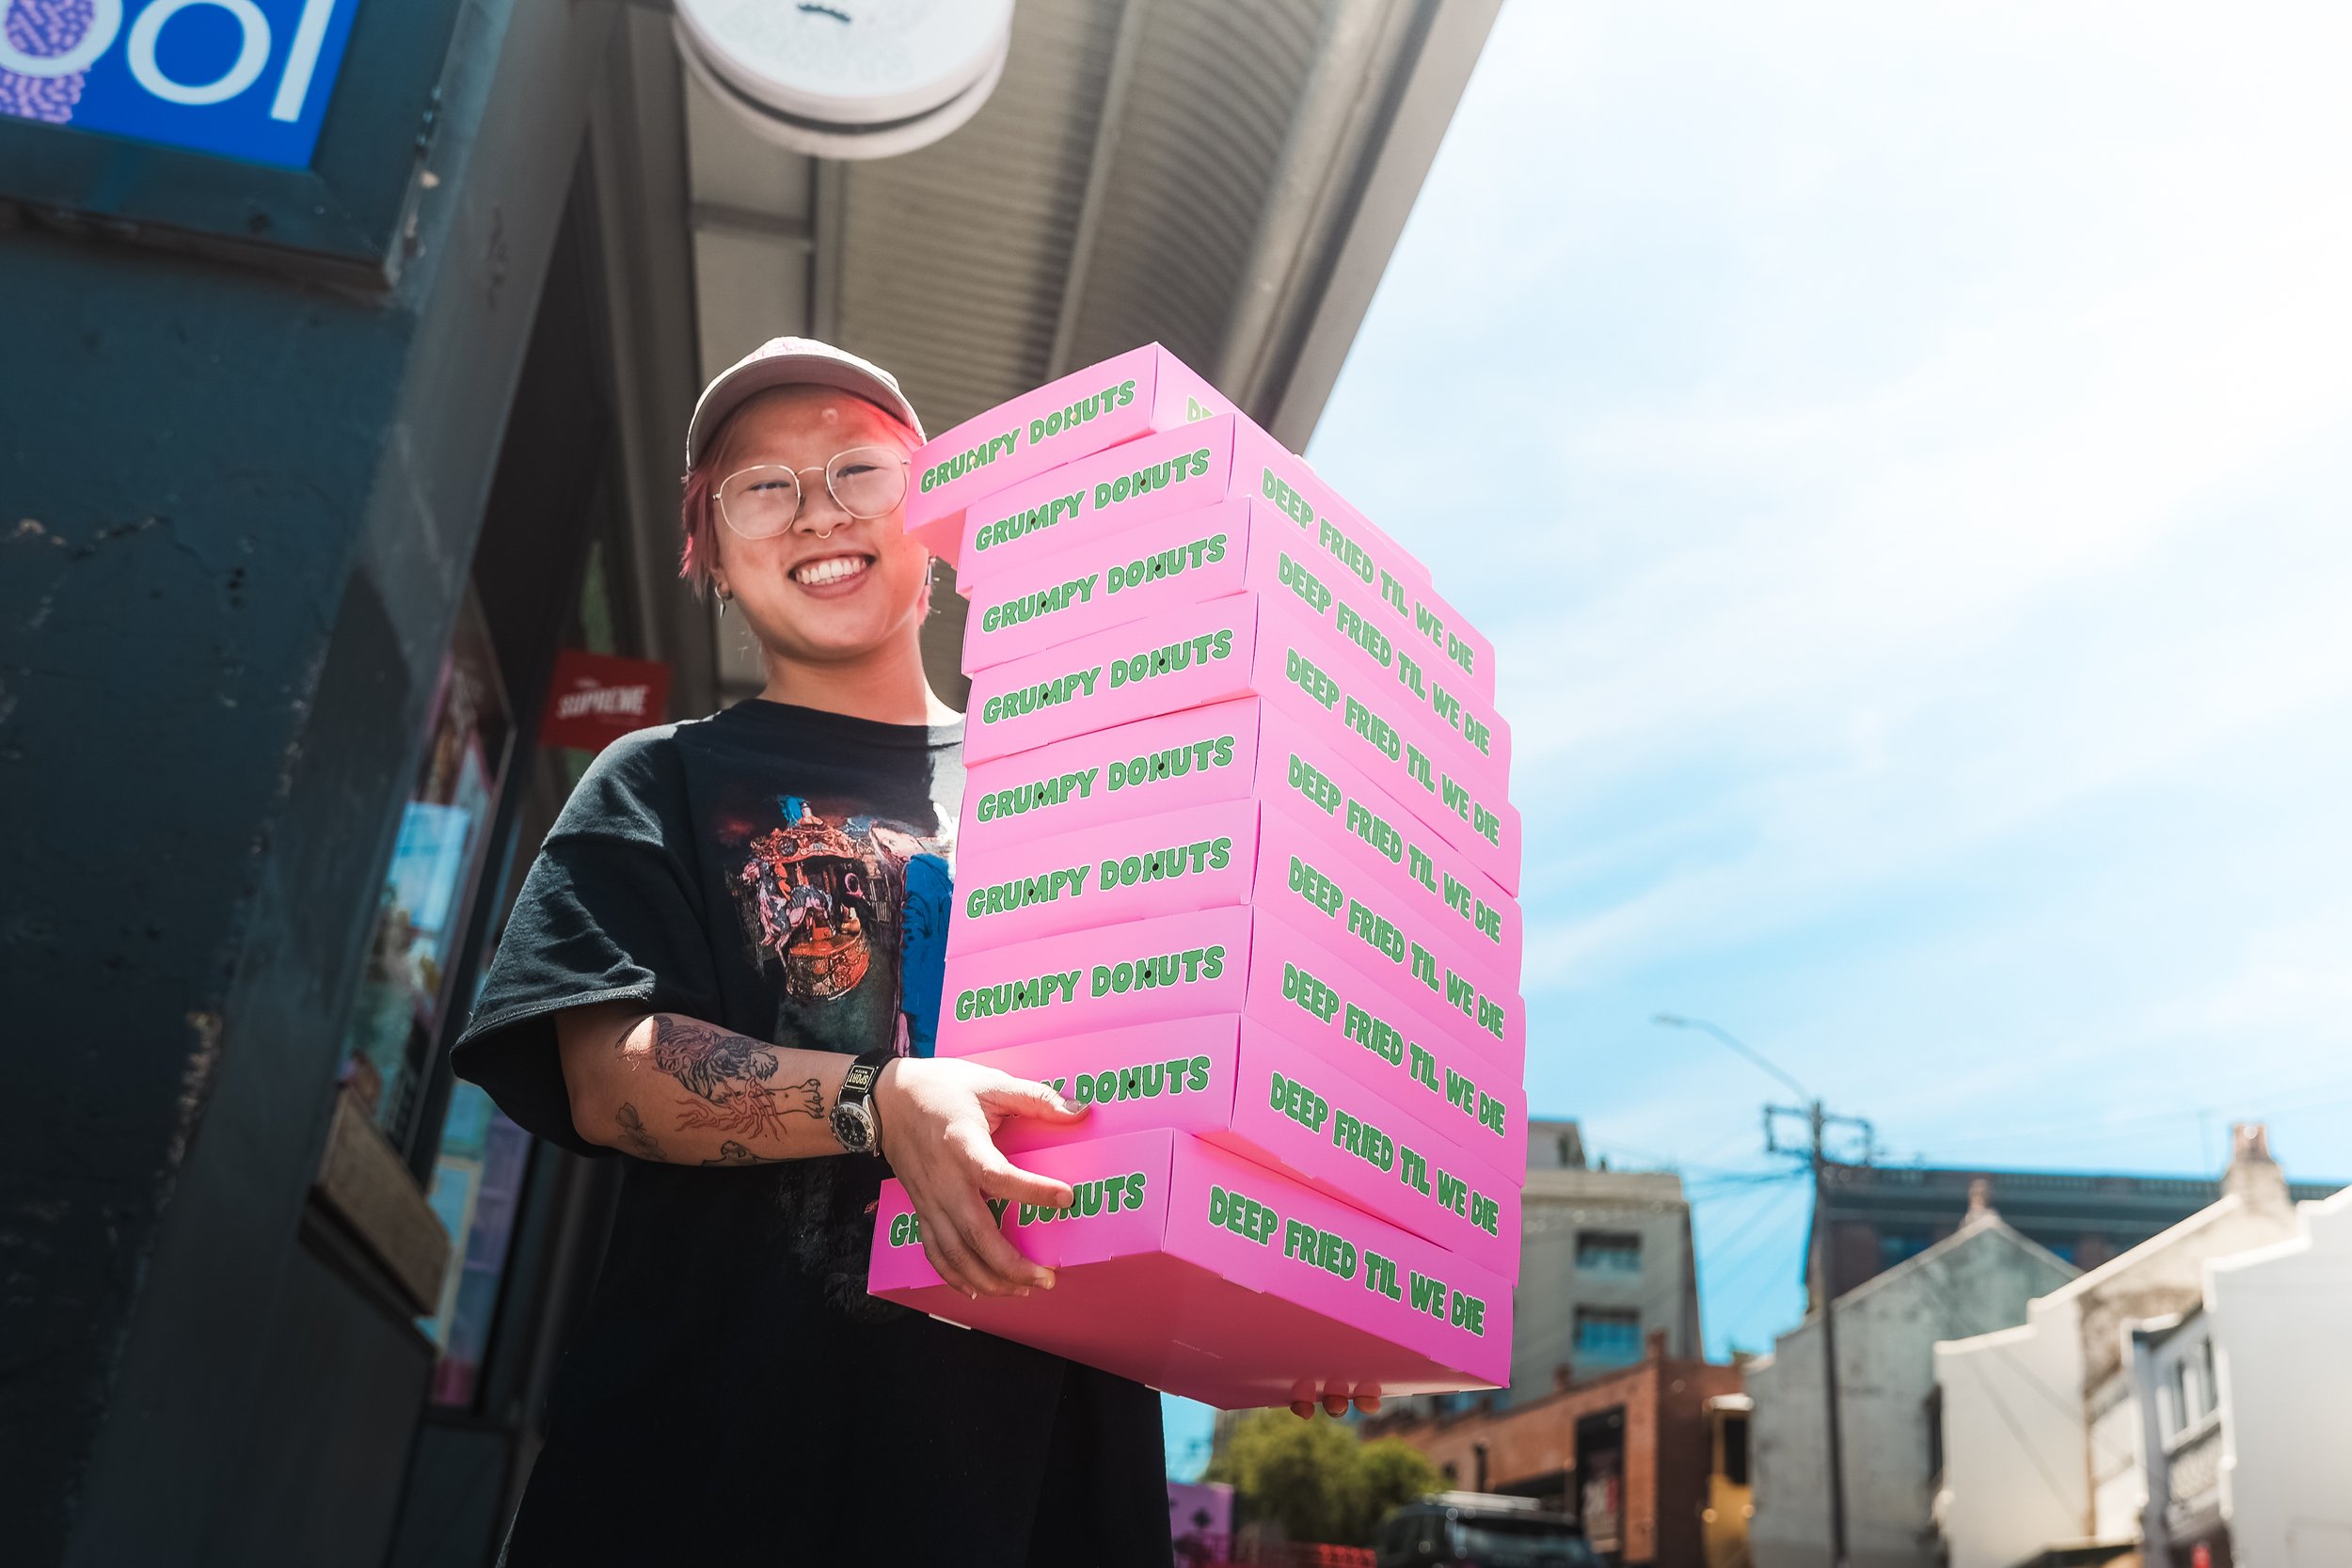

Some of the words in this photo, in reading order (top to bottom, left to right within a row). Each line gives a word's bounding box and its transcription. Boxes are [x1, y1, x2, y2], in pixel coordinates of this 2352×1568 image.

[921, 428, 1021, 493] GRUMPY
[1029, 380, 1136, 445] DONUTS
[975, 490, 1085, 551] GRUMPY
[1094, 448, 1211, 510] DONUTS
[982, 574, 1099, 633] GRUMPY
[1107, 533, 1228, 594] DONUTS
[1262, 468, 1314, 530] DEEP
[1319, 518, 1375, 584] FRIED
[1380, 570, 1408, 617] TIL
[1415, 601, 1443, 648] WE
[1448, 632, 1474, 674] DIE
[982, 666, 1102, 724] GRUMPY
[1110, 628, 1233, 689] DONUTS
[1279, 553, 1332, 614] DEEP
[1336, 601, 1392, 668] FRIED
[1397, 651, 1427, 701] TIL
[1432, 683, 1461, 729] WE
[1464, 712, 1490, 756] DIE
[977, 767, 1099, 823] GRUMPY
[1107, 735, 1235, 791] DONUTS
[1286, 648, 1341, 711] DEEP
[1344, 695, 1401, 762] FRIED
[1406, 743, 1436, 793] TIL
[1441, 774, 1470, 821] WE
[1473, 802, 1500, 847] DIE
[966, 864, 1090, 919] GRUMPY
[1100, 837, 1232, 891] DONUTS
[1288, 753, 1343, 815] DEEP
[1346, 798, 1403, 863] FRIED
[1408, 844, 1438, 893] TIL
[1443, 872, 1471, 919] WE
[1474, 899, 1502, 943] DIE
[955, 970, 1082, 1022] GRUMPY
[1091, 944, 1226, 998] DONUTS
[1289, 856, 1344, 918] DEEP
[1347, 898, 1406, 963] FRIED
[1410, 942, 1439, 992] TIL
[1446, 969, 1474, 1017] WE
[1478, 995, 1505, 1039] DIE
[849, 1072, 869, 1085] SPORT
[1076, 1056, 1210, 1104] DONUTS
[1282, 962, 1340, 1023] DEEP
[1343, 1003, 1404, 1067] FRIED
[1409, 1042, 1439, 1092] TIL
[1446, 1068, 1475, 1115] WE
[1478, 1091, 1506, 1136] DIE
[1270, 1072, 1328, 1132] DEEP
[1333, 1109, 1394, 1172] FRIED
[1400, 1146, 1431, 1196] TIL
[1437, 1169, 1468, 1216] WE
[1470, 1192, 1499, 1236] DIE
[1209, 1186, 1279, 1245] DEEP
[1284, 1219, 1358, 1280] FRIED
[1364, 1251, 1402, 1301] TIL
[1410, 1272, 1447, 1319] WE
[1451, 1291, 1486, 1336] DIE
